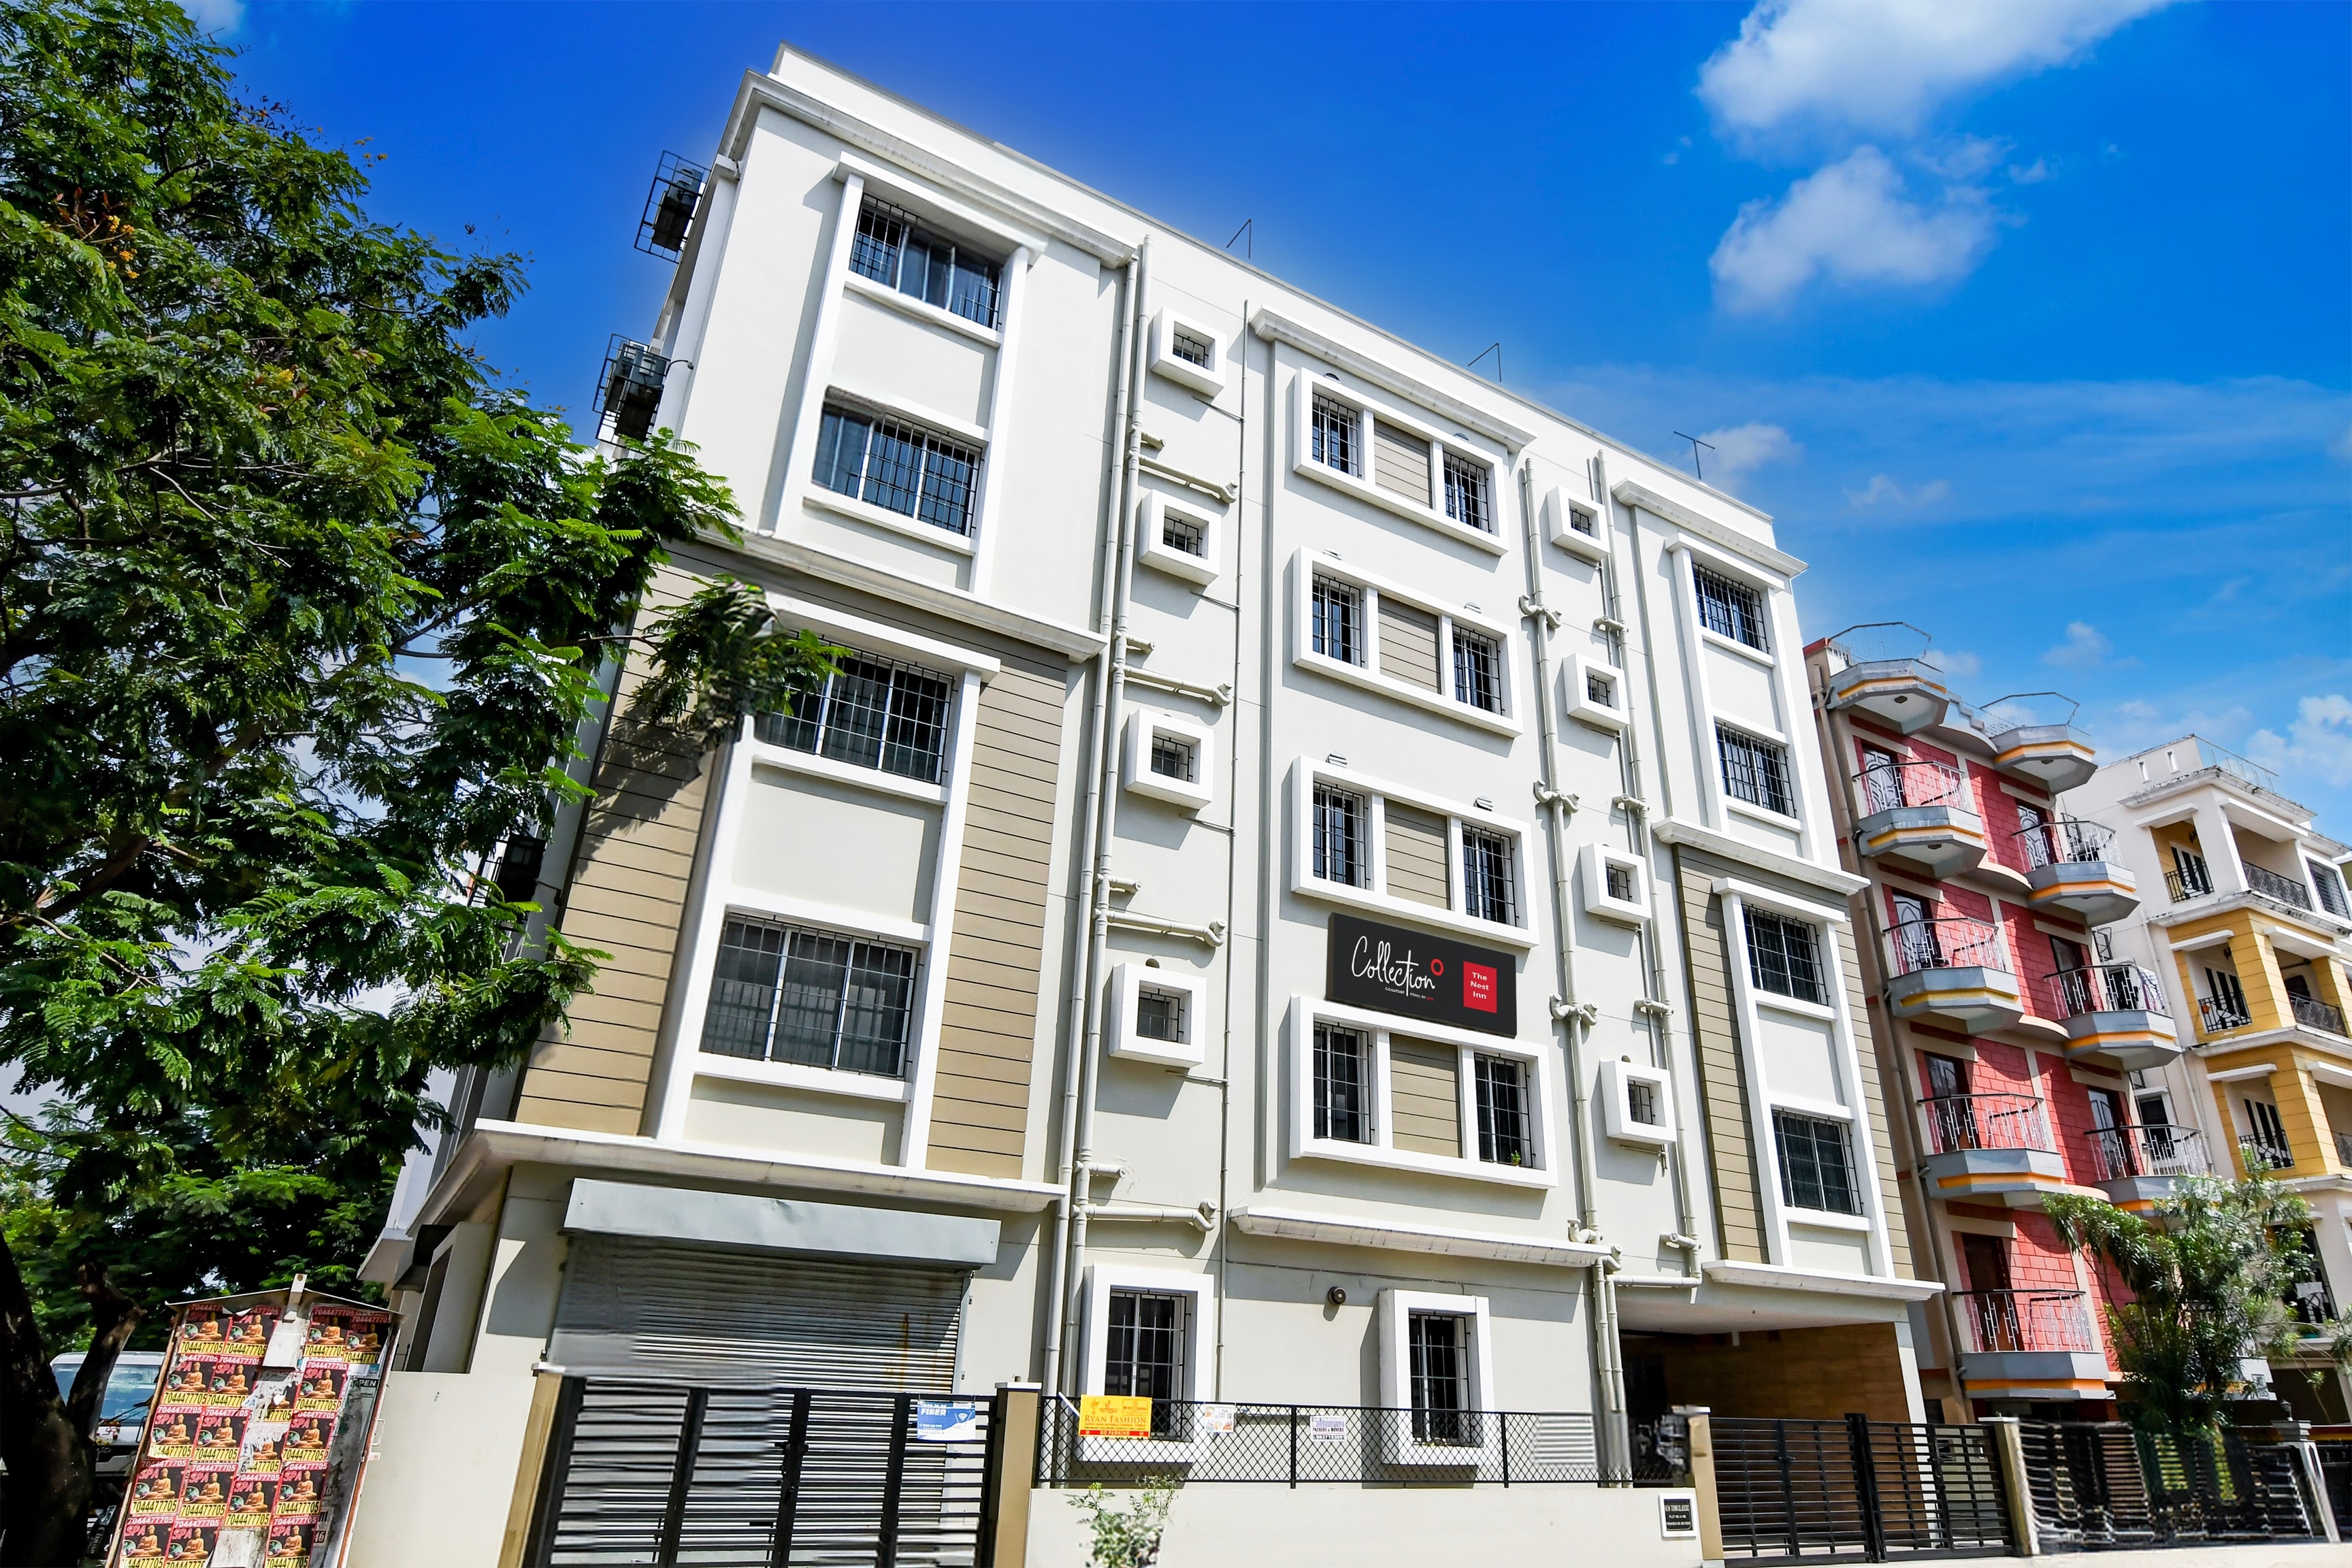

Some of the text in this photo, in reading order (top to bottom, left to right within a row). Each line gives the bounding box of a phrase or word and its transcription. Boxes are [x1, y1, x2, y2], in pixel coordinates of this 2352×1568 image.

[1351, 936, 1435, 996] Collection
[1471, 972, 1488, 981] The
[1470, 981, 1489, 991] Nest
[1473, 991, 1487, 1000] Inn
[181, 1341, 223, 1352] 7044477705
[225, 1343, 267, 1356] 7044477705
[344, 1352, 380, 1362] 704447770
[176, 1362, 192, 1372] PA
[216, 1364, 235, 1374] SPA
[308, 1362, 347, 1370] 7044477705
[305, 1369, 323, 1379] SPA
[359, 1379, 376, 1387] PEN
[163, 1392, 208, 1404] 7044477705
[296, 1399, 337, 1410] 7044477705
[155, 1414, 176, 1425] SPA
[203, 1417, 222, 1427] SPA
[291, 1418, 310, 1428] SPA
[195, 1448, 238, 1460] 7044477705
[283, 1449, 325, 1460] 7044477705
[139, 1468, 159, 1480] SPA
[189, 1472, 210, 1483] SPA
[283, 1471, 302, 1482] SPA
[234, 1482, 255, 1492] SPA
[133, 1500, 178, 1512] 7044477705
[182, 1505, 226, 1516] 7044477705
[278, 1502, 319, 1514] 7044477705
[128, 1516, 174, 1524] 7044477705
[227, 1514, 270, 1525] 7044477705
[274, 1517, 316, 1525] 7044477705
[125, 1525, 146, 1537] SPA
[172, 1529, 193, 1539] SPA
[272, 1526, 291, 1537] SPA
[267, 1556, 308, 1568] 7044477705
